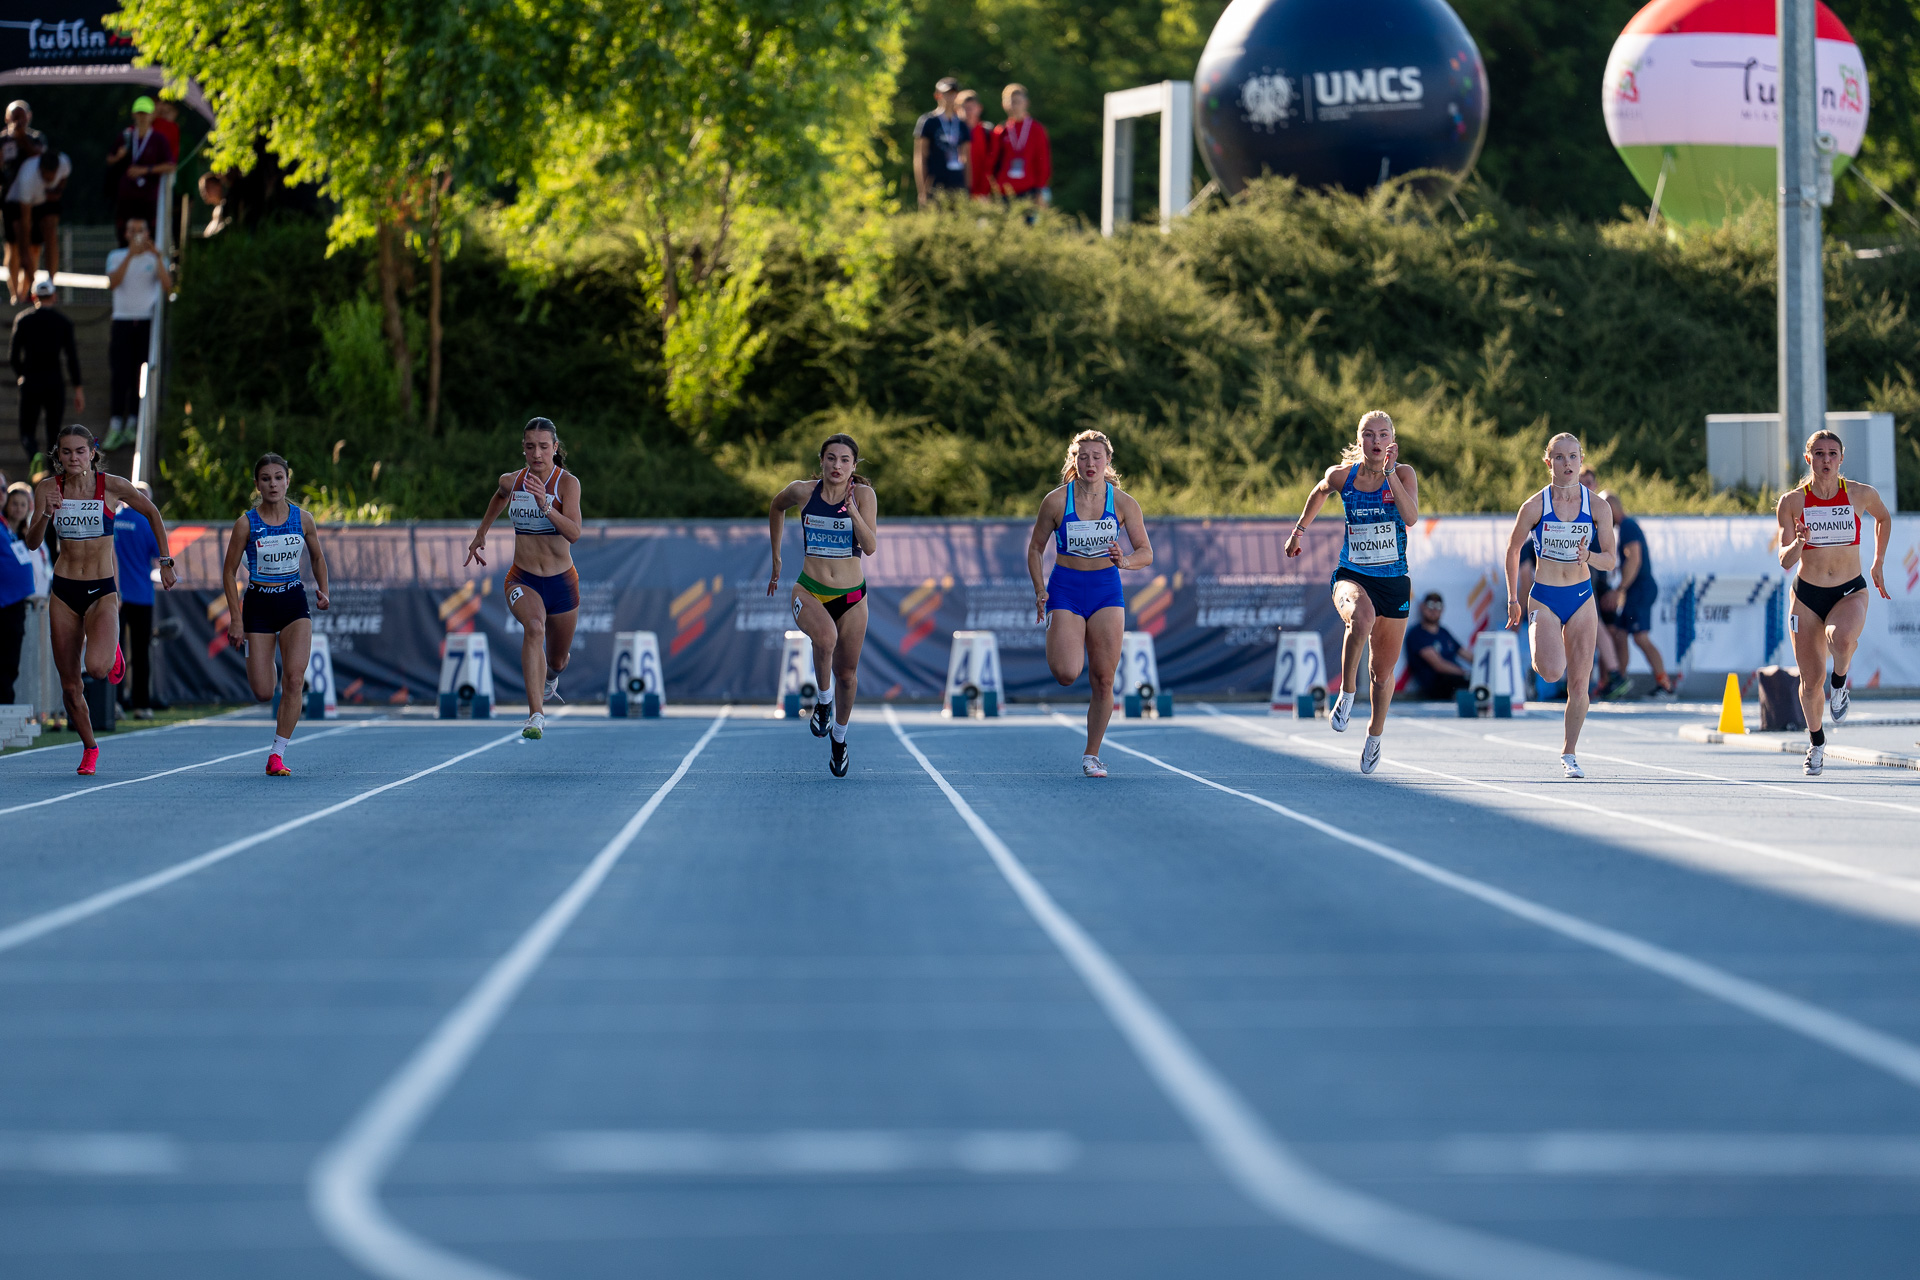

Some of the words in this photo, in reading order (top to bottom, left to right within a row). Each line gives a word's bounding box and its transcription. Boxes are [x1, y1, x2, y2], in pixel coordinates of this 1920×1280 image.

[1313, 66, 1424, 106] UMCS
[80, 502, 99, 511] 222
[510, 508, 548, 519] MICHALU
[1351, 507, 1386, 517] VECTRA
[1831, 507, 1850, 516] 526
[56, 516, 100, 526] ROZMYS
[833, 521, 845, 530] 85
[1094, 522, 1113, 531] 706
[1806, 521, 1855, 532] ROMANIUK
[1373, 524, 1392, 535] 135
[1570, 525, 1589, 534] 250
[284, 536, 301, 546] 125
[806, 531, 851, 544] KASPRZAK
[1069, 535, 1114, 547] PUŁAWSKA
[1544, 537, 1588, 549] PIATKOWSA
[1350, 538, 1395, 552] WOŹNIAK
[263, 550, 299, 563] CIUPAK
[258, 585, 286, 594] NIKE
[287, 579, 302, 590] PR
[512, 589, 520, 602] 6
[1789, 616, 1798, 632] 1
[311, 652, 327, 692] 8
[448, 651, 466, 693] 7
[473, 651, 485, 695] 7
[616, 650, 631, 693] 6
[640, 650, 657, 693] 6
[785, 650, 801, 693] 5
[953, 649, 972, 687] 4
[980, 649, 997, 687] 4
[1135, 651, 1151, 685] 3
[1280, 650, 1297, 696] 2
[1303, 650, 1319, 692] 2
[1478, 650, 1491, 684] 1
[1502, 650, 1515, 696] 1
